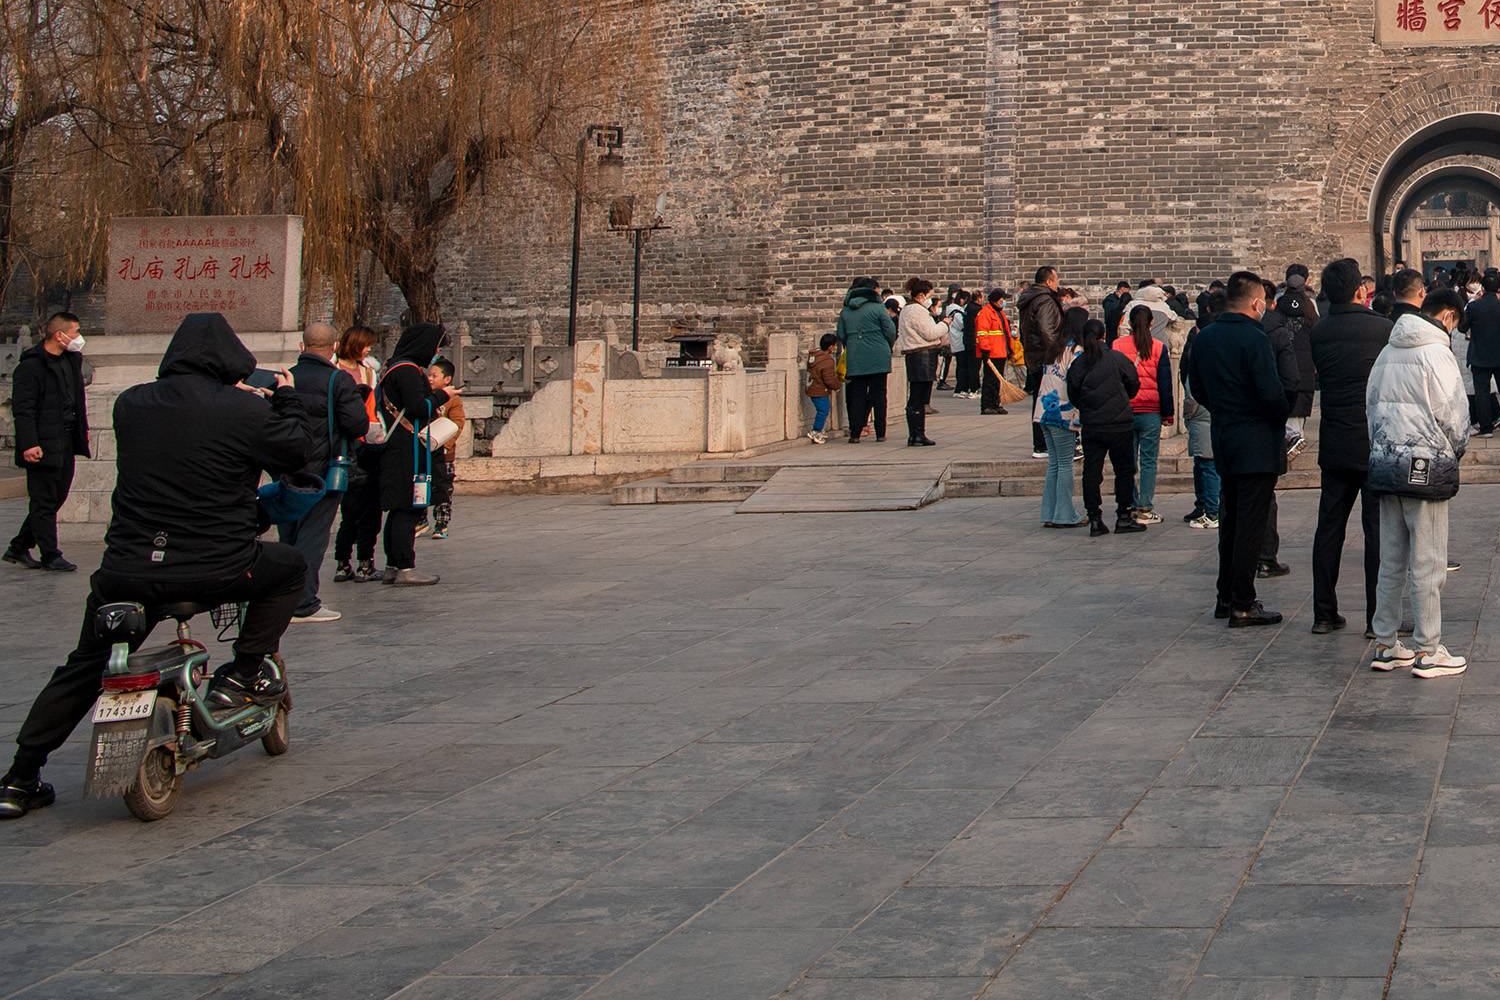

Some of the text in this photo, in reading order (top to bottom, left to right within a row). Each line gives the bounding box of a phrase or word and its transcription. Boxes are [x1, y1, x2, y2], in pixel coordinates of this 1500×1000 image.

[118, 253, 275, 281] 孔庙 孔府 孔林
[99, 703, 149, 718] 1743148
